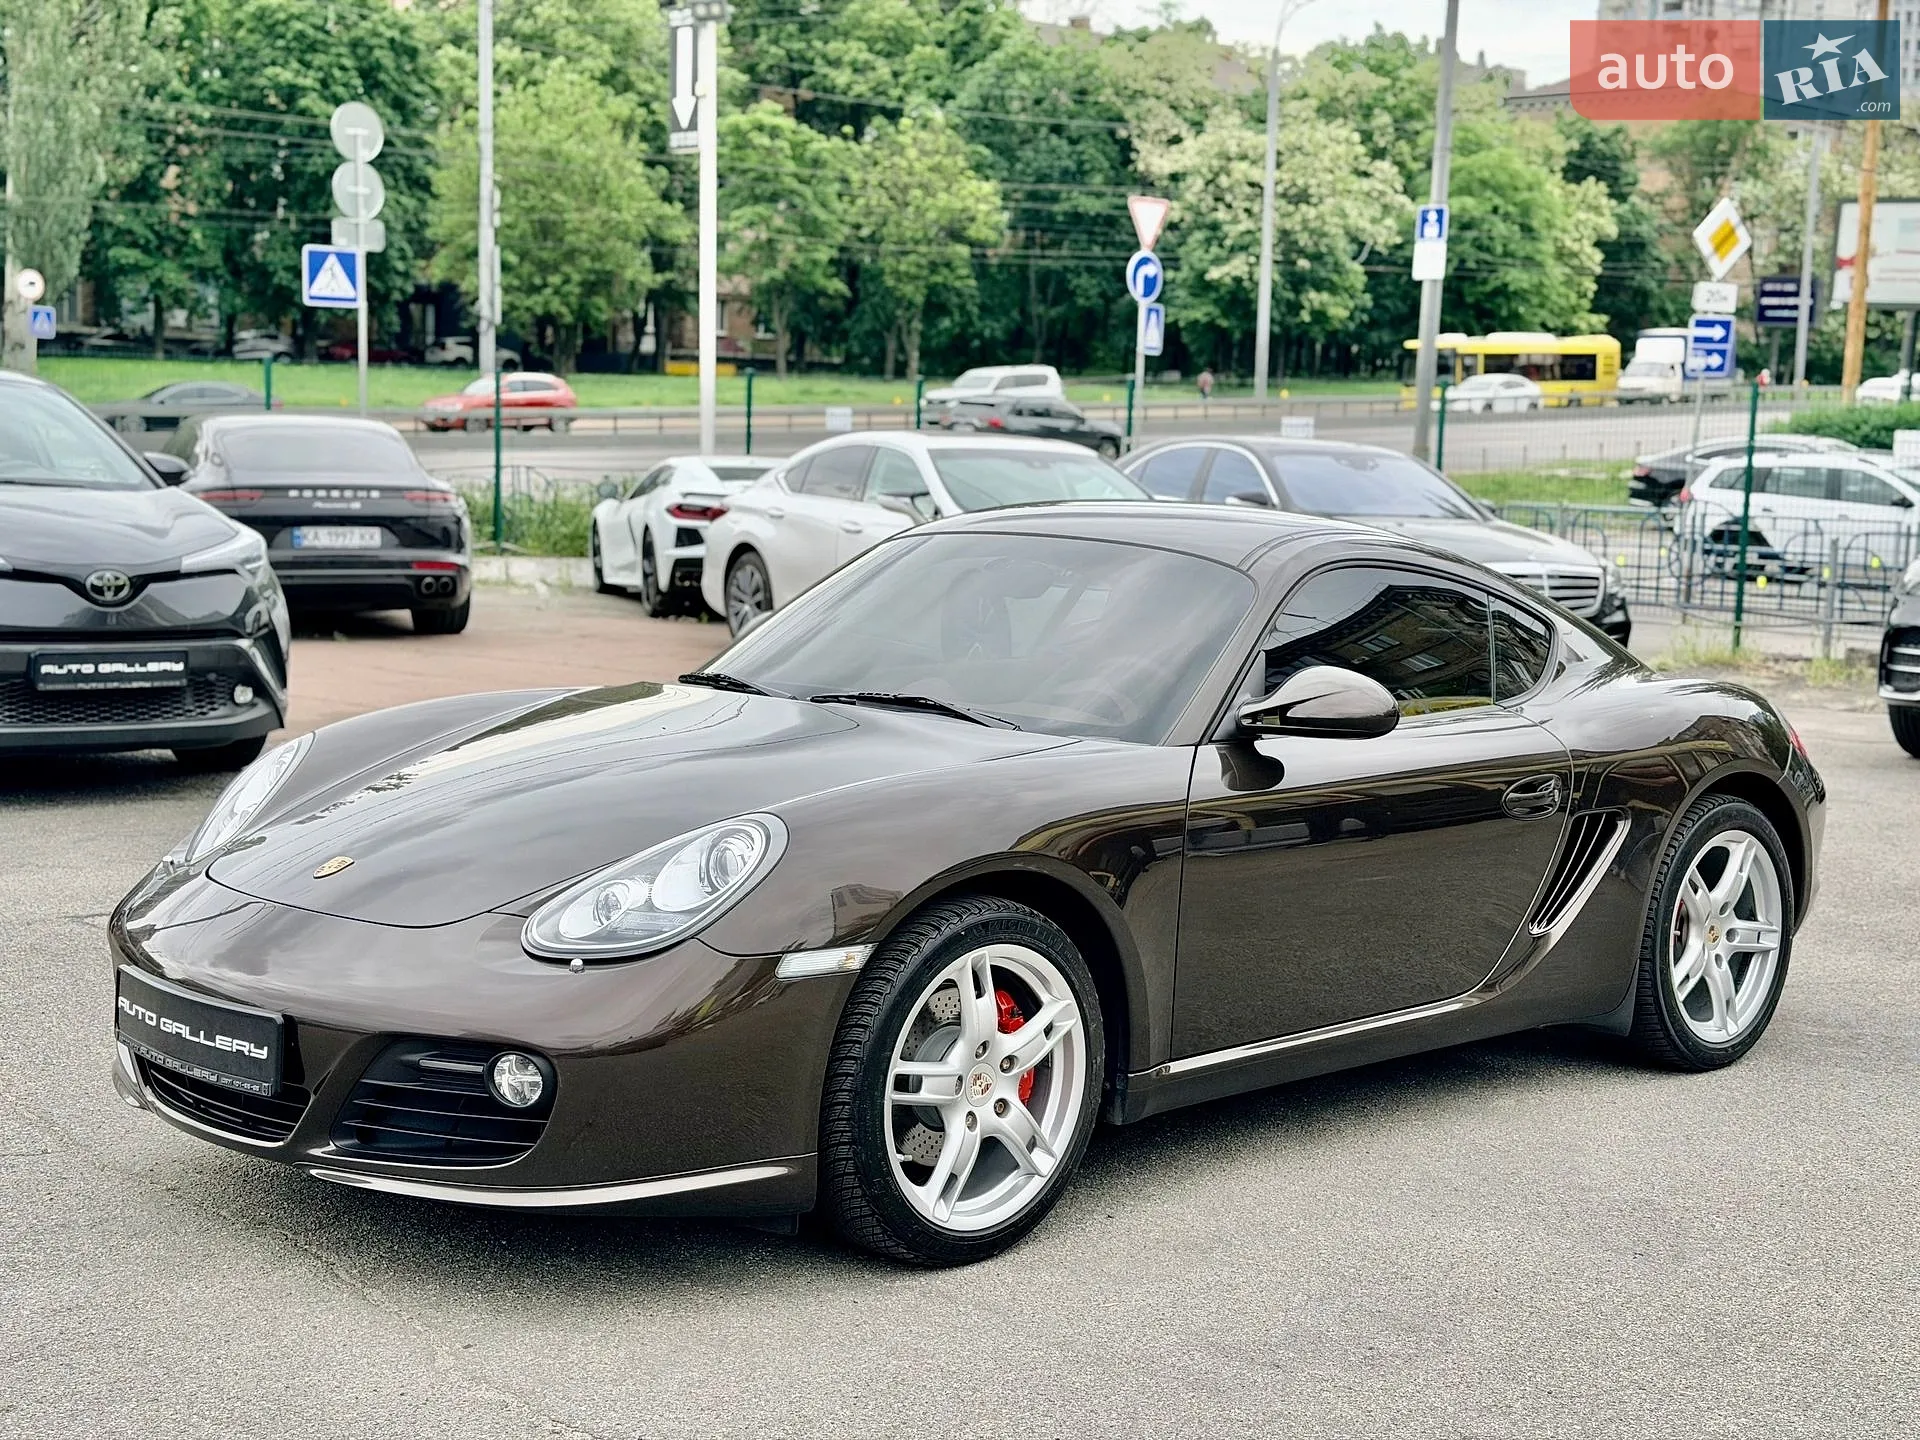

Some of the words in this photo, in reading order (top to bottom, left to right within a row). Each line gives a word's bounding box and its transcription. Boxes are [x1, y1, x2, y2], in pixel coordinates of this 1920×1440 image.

[40, 664, 95, 675] AUTO
[97, 661, 185, 673] GALLERY
[118, 995, 157, 1027] AUTO
[160, 1017, 268, 1060] GALLERY
